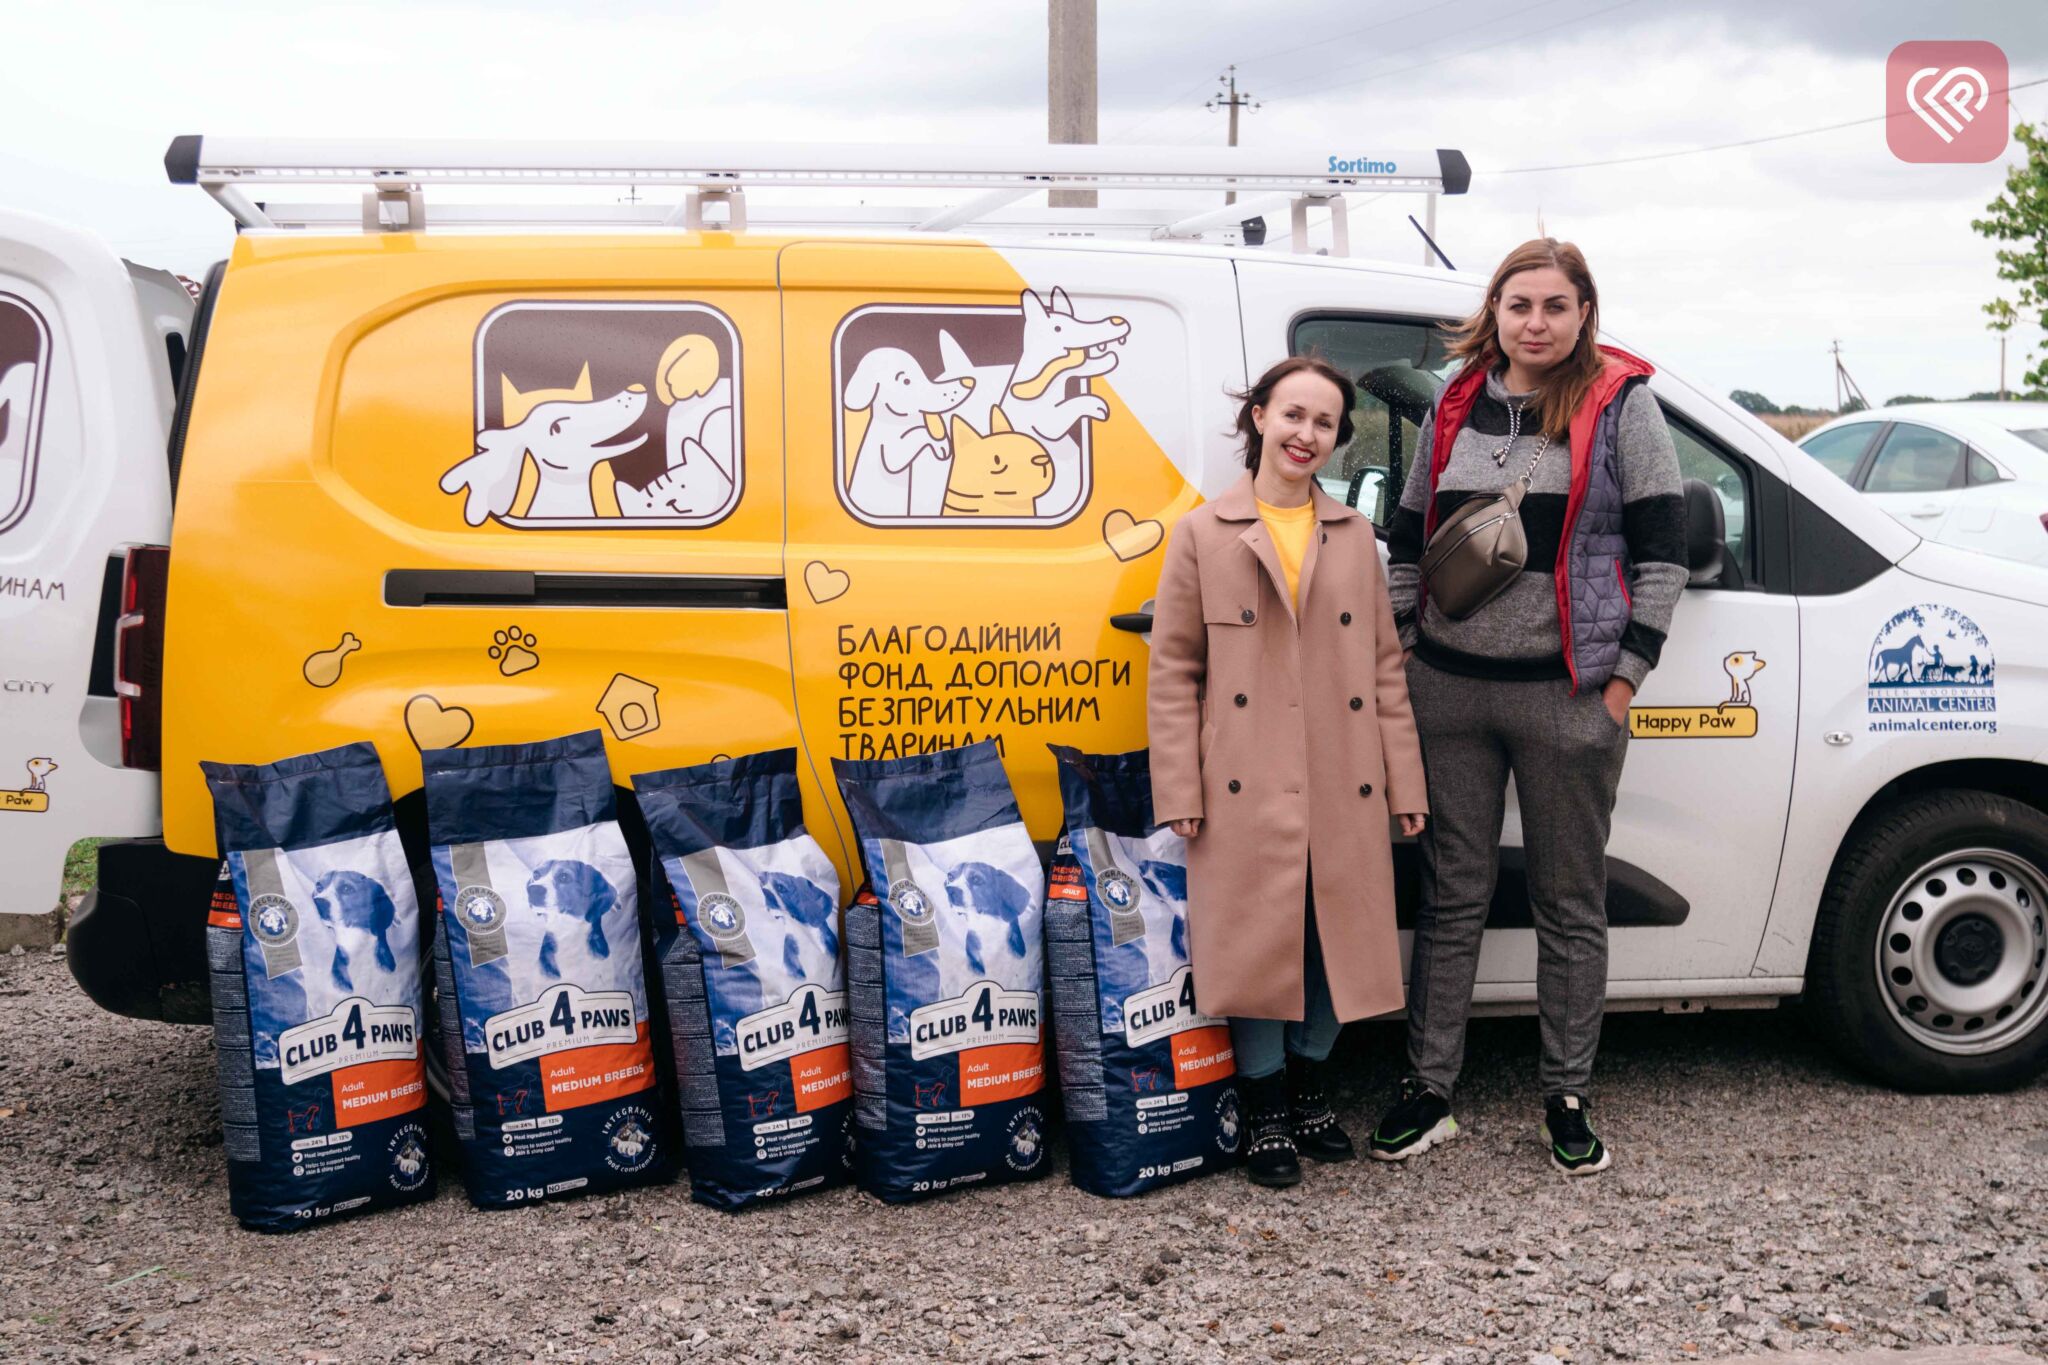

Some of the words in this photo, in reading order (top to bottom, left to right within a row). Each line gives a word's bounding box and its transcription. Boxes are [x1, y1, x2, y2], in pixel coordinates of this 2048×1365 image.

[1328, 155, 1397, 174] Sortimo
[838, 622, 1062, 656] БЛАГОДІЙНИЙ
[838, 662, 933, 691] ФОНД
[945, 659, 1131, 691] ДОПОМОГИ
[3, 680, 54, 694] CITY
[1868, 689, 1909, 697] HELEN
[838, 696, 1101, 728] БЕЗПРИТУЛЬНИМ
[1870, 698, 1934, 712] ANIMAL
[1939, 698, 1995, 712] CENTER
[1637, 714, 1691, 732] Happy
[1700, 713, 1736, 729] Paw
[1869, 719, 1997, 733] animalcenter.org
[6, 794, 33, 806] Paw
[251, 896, 293, 918] INTEGRAMIX
[1130, 999, 1176, 1030] CLUB
[1179, 971, 1196, 1015] 4
[492, 1020, 546, 1052] CLUB
[550, 990, 576, 1036] 4
[581, 1009, 630, 1029] PAWS
[743, 1020, 795, 1054] CLUB
[798, 990, 821, 1035] 4
[824, 1007, 850, 1028] PAW
[916, 1014, 967, 1043] CLUB
[971, 987, 994, 1032] 4
[999, 1008, 1037, 1027] PAWS
[286, 1034, 338, 1067] CLUB
[342, 1004, 366, 1050] 4
[371, 1024, 413, 1043] PAWS
[546, 1036, 590, 1050] PREMIUM
[967, 1033, 1005, 1045] PREMIUM
[796, 1036, 832, 1051] PREMIUM
[338, 1050, 379, 1064] PREMIUM
[1179, 1056, 1215, 1072] MEDIUM
[550, 1066, 575, 1078] Adult
[800, 1067, 821, 1078] Adult
[967, 1062, 990, 1073] Adult
[552, 1075, 601, 1095] MEDIUM
[604, 1063, 645, 1083] BREEDS
[967, 1073, 1011, 1089] MEDIUM
[1012, 1064, 1042, 1082] BREEDS
[341, 1081, 365, 1094] Adult
[801, 1076, 841, 1095] MEDIUM
[342, 1091, 388, 1110] MEDIUM
[390, 1081, 423, 1099] BREEDS
[601, 1106, 654, 1135] INTEGRAMIX
[604, 1155, 620, 1170] Food
[1139, 1167, 1155, 1179] 20
[1157, 1165, 1171, 1176] kg
[549, 1184, 561, 1193] NO
[912, 1181, 930, 1192] 20
[932, 1180, 948, 1190] kg
[506, 1189, 524, 1201] 20
[527, 1187, 544, 1199] kg
